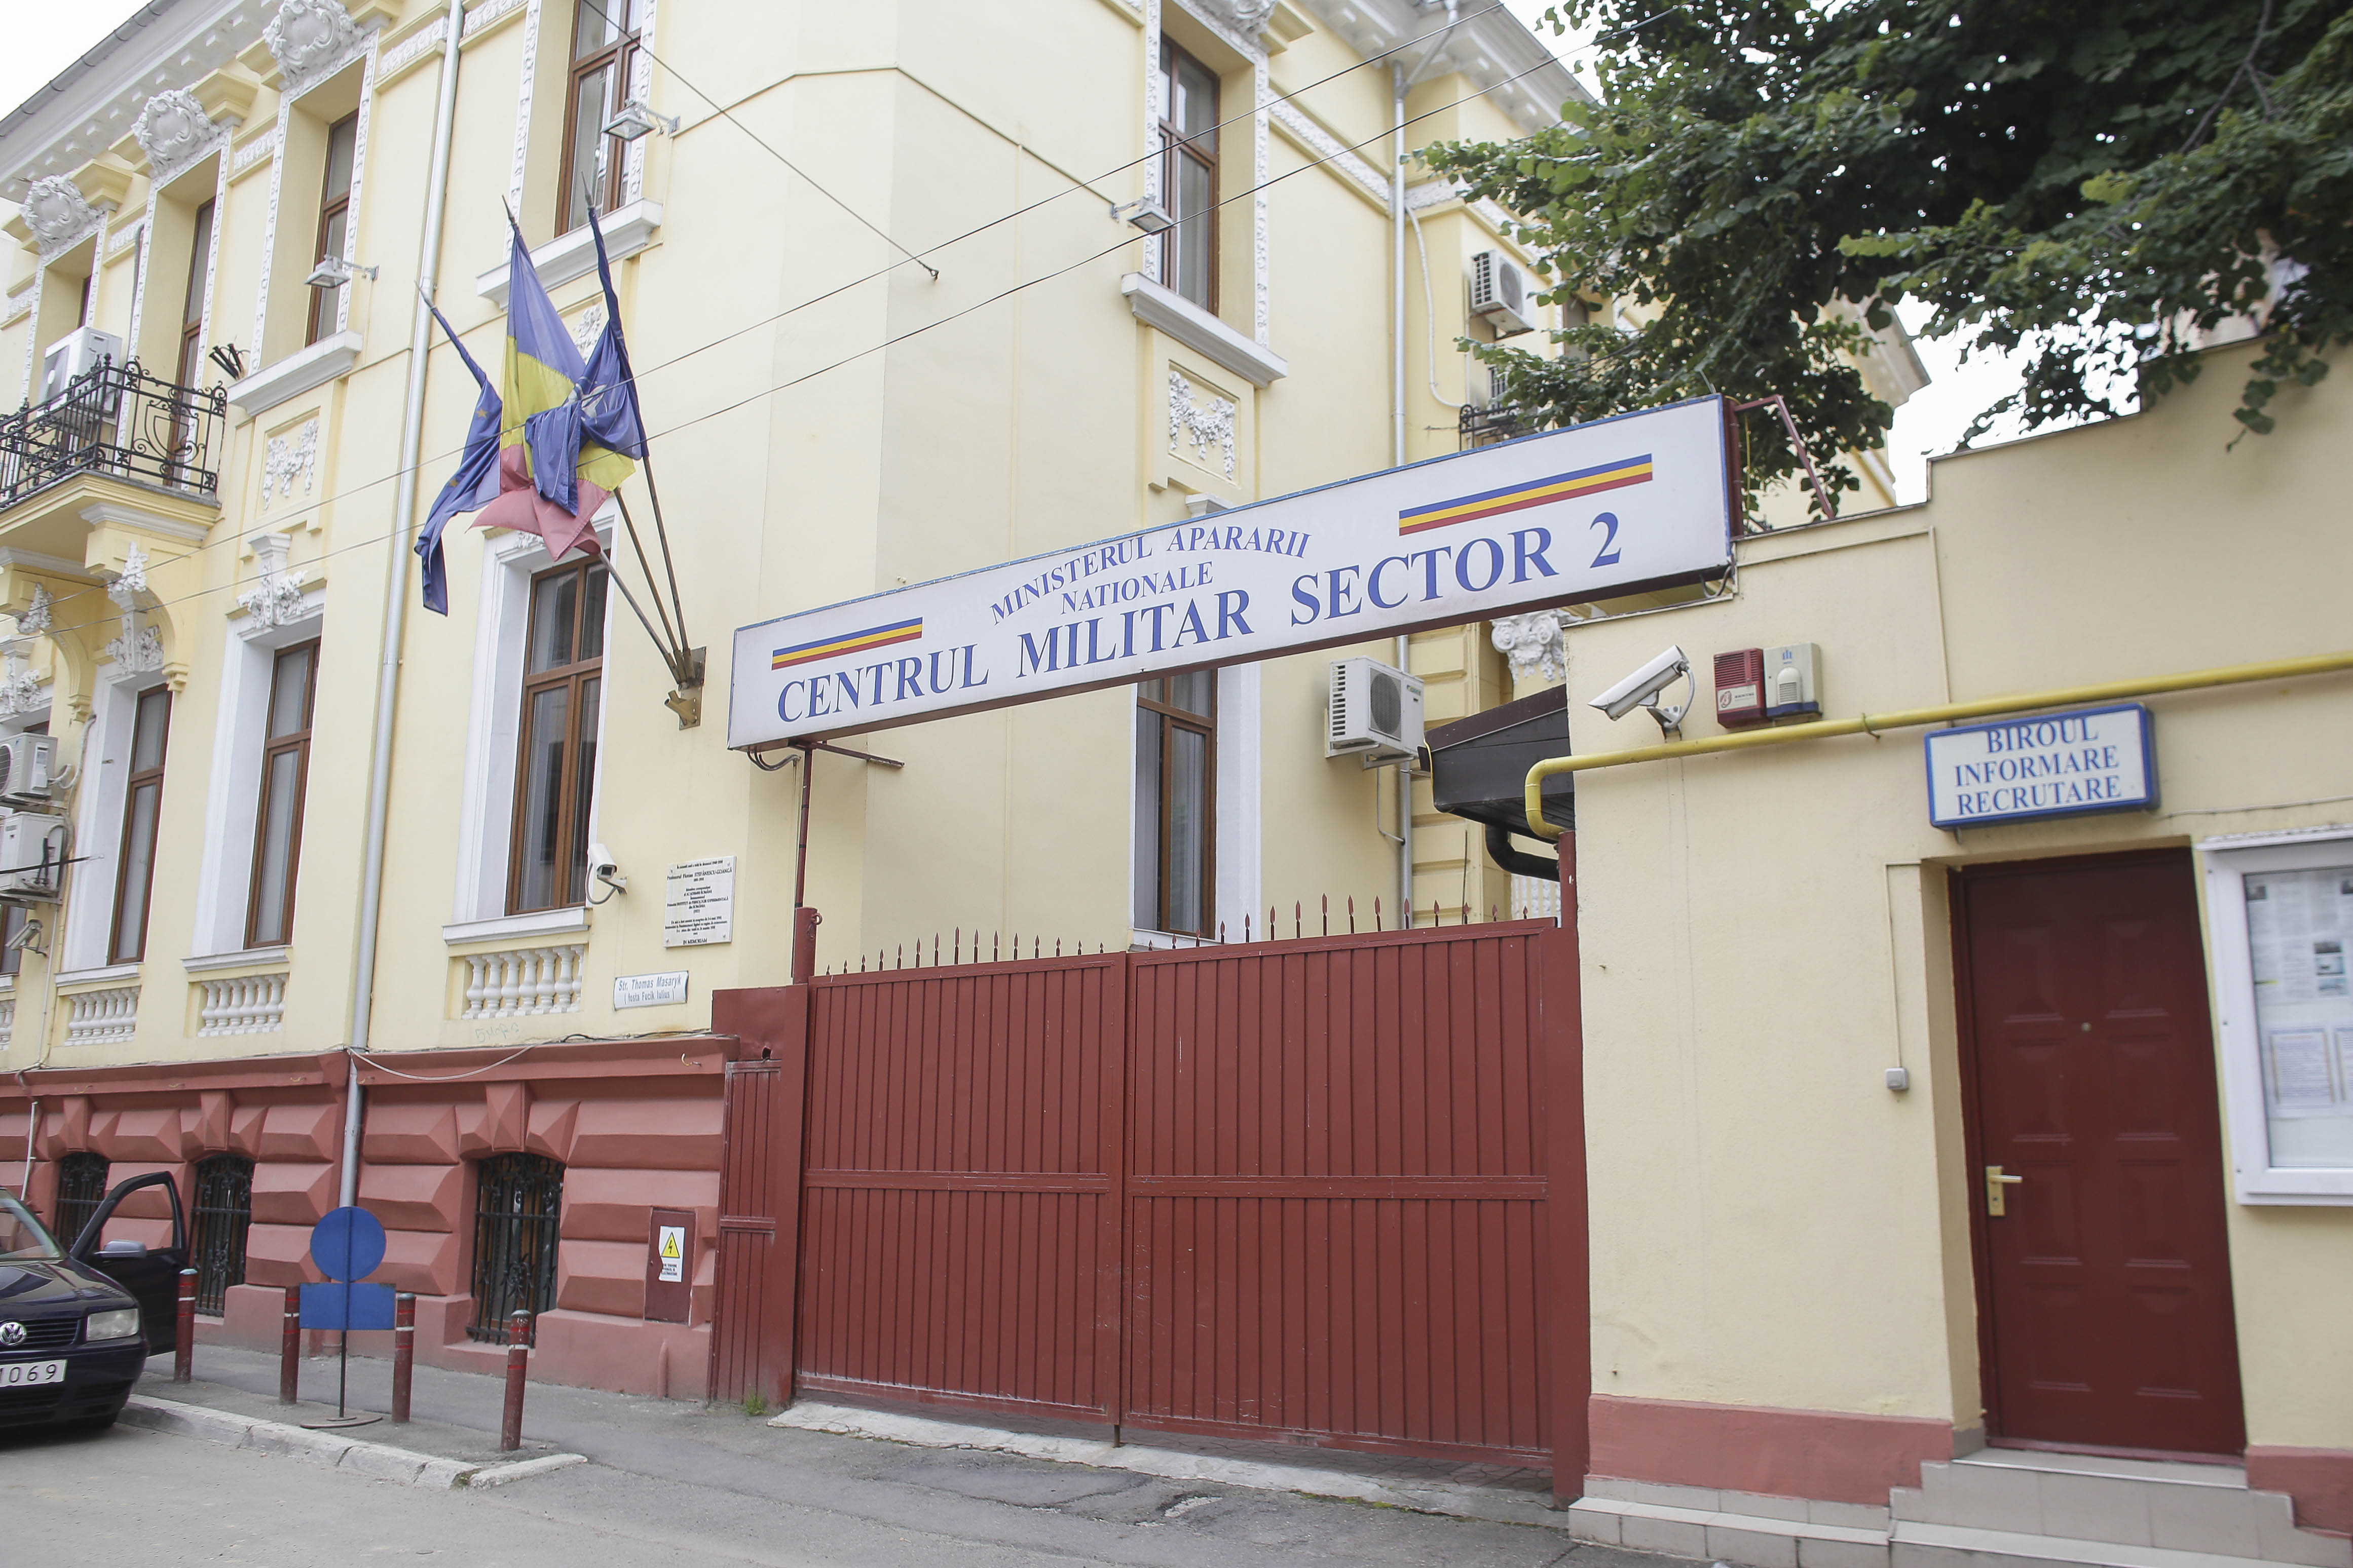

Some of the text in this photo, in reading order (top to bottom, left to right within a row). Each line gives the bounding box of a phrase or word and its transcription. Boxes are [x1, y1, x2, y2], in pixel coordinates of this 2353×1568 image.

[990, 525, 1311, 625] MINISTERUL APARARII
[1061, 561, 1213, 613] NATIONALE
[778, 511, 1623, 722] CENTRUL MILITAR SECTOR 2
[1986, 718, 2098, 754] BIROUL
[1955, 745, 2120, 787] INFORMARE
[1958, 775, 2121, 815] RECRUTARE
[618, 974, 682, 991] Str. Thomas Masaryk
[642, 990, 655, 1001] Fucik
